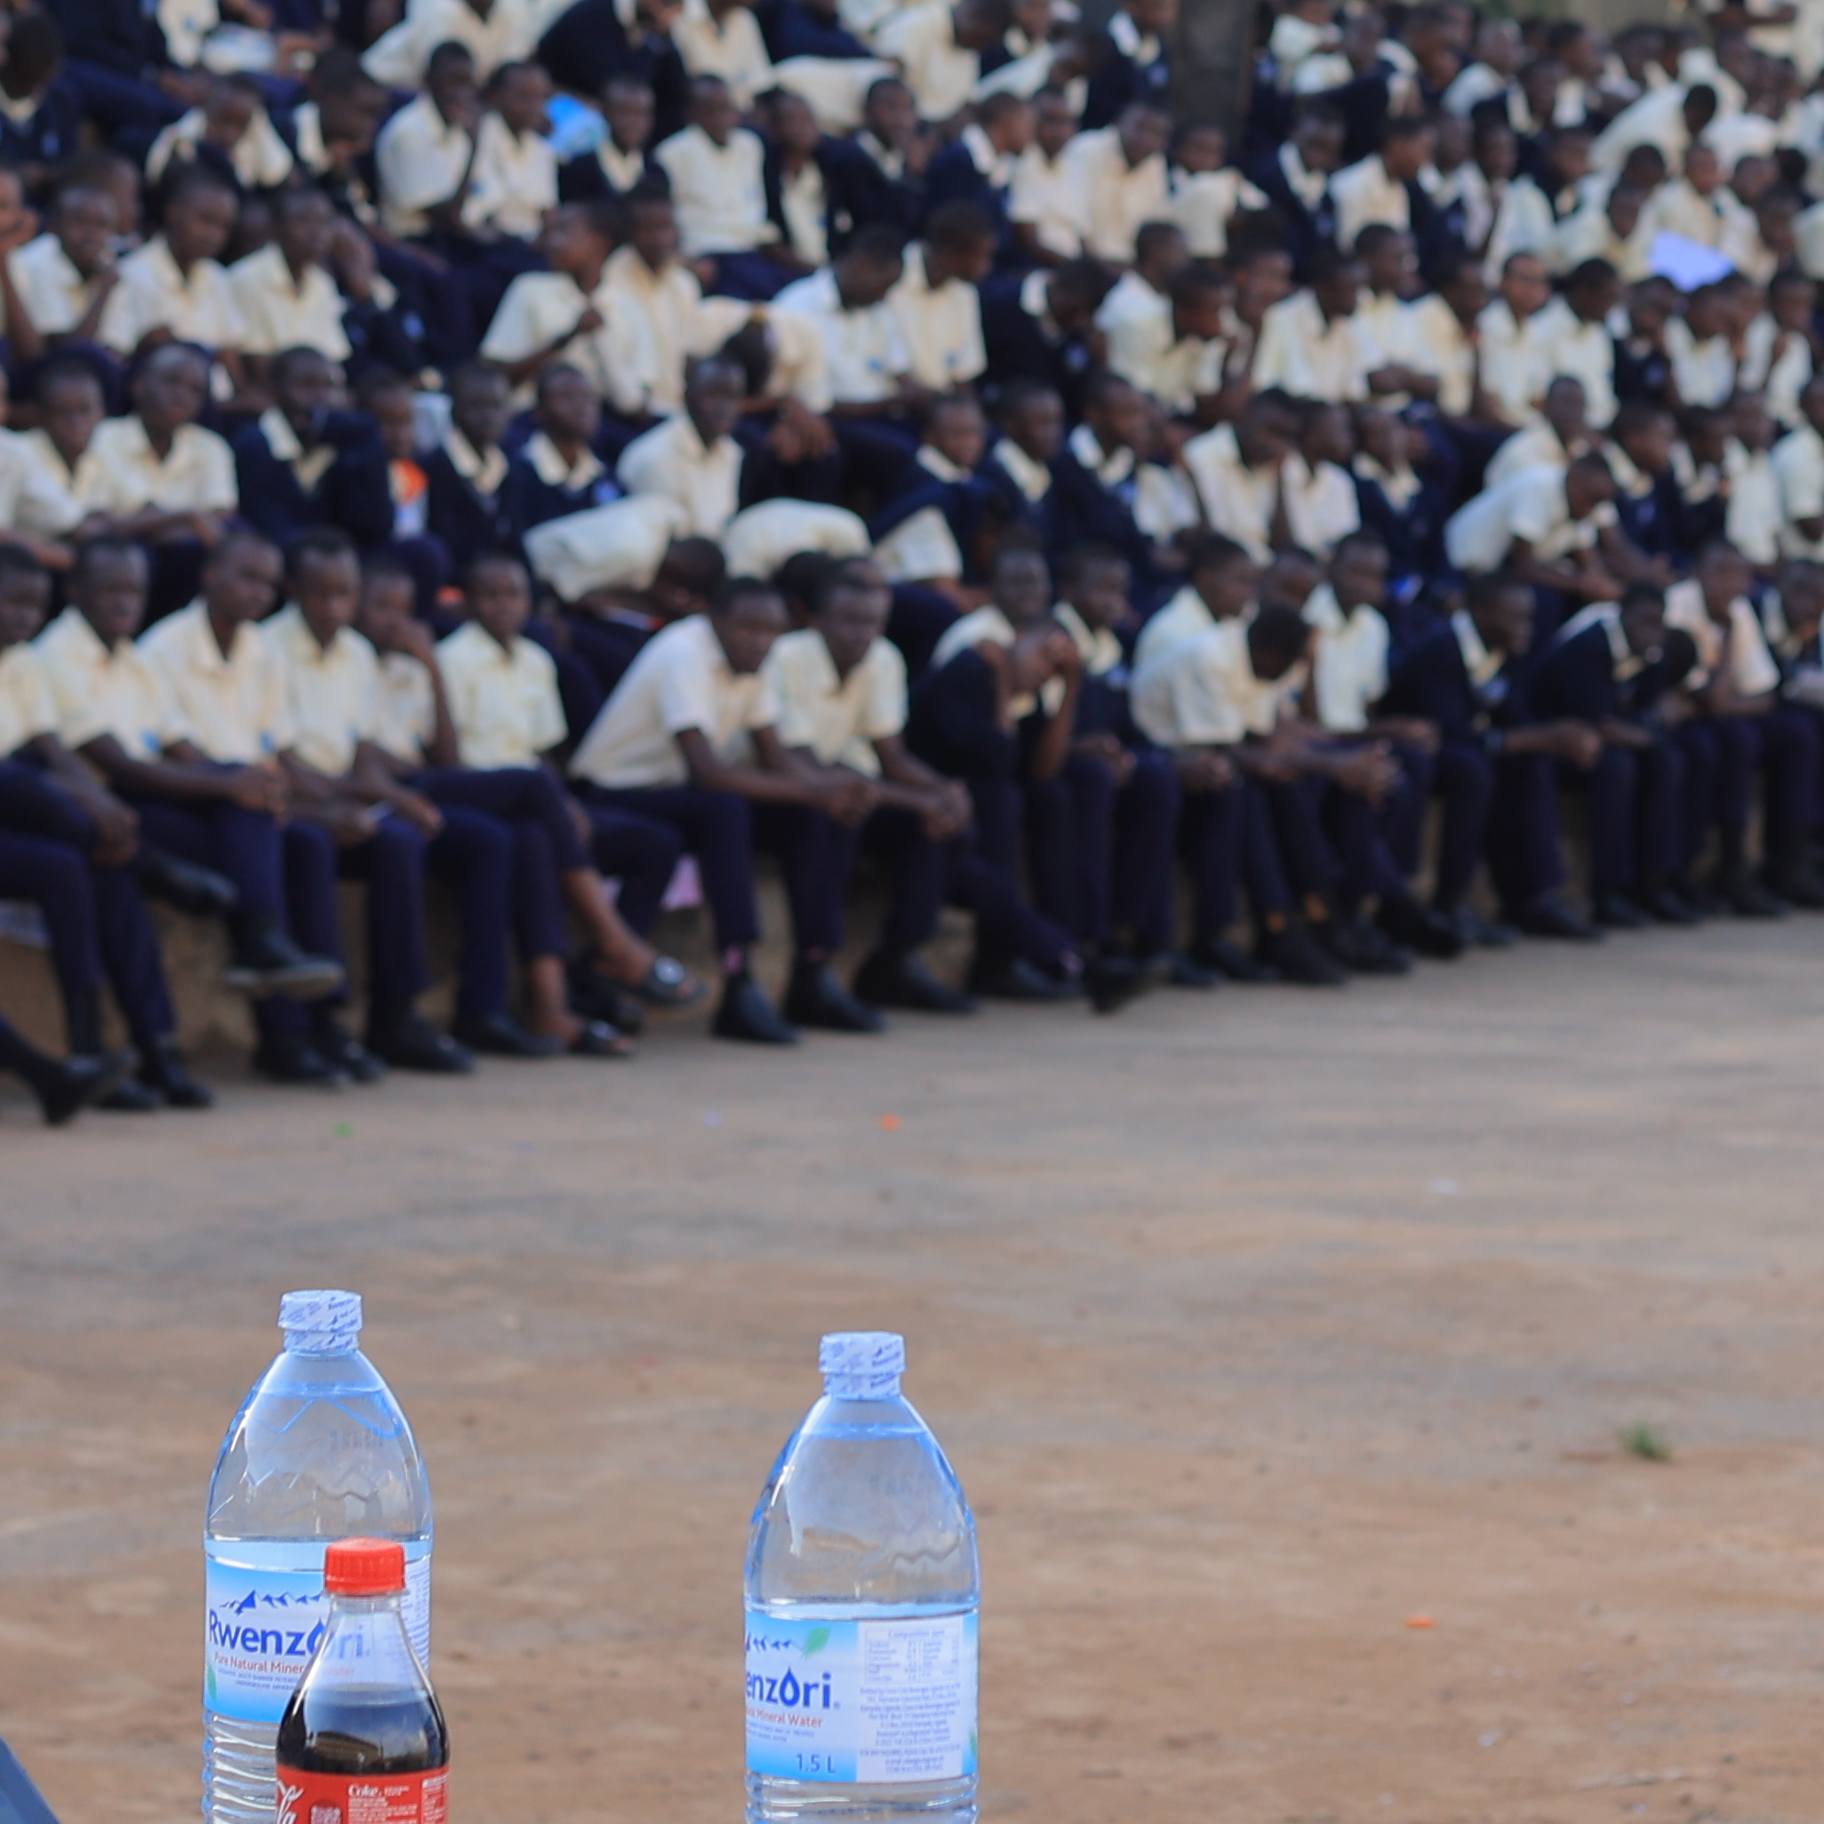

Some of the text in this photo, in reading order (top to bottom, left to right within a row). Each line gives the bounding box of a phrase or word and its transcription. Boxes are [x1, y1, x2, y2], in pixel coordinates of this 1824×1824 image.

[230, 1656, 268, 1672] Natural
[270, 1661, 304, 1674] Miner
[746, 1665, 832, 1710] enzori
[787, 1713, 823, 1728] Water
[797, 1753, 836, 1773] 1.5 L
